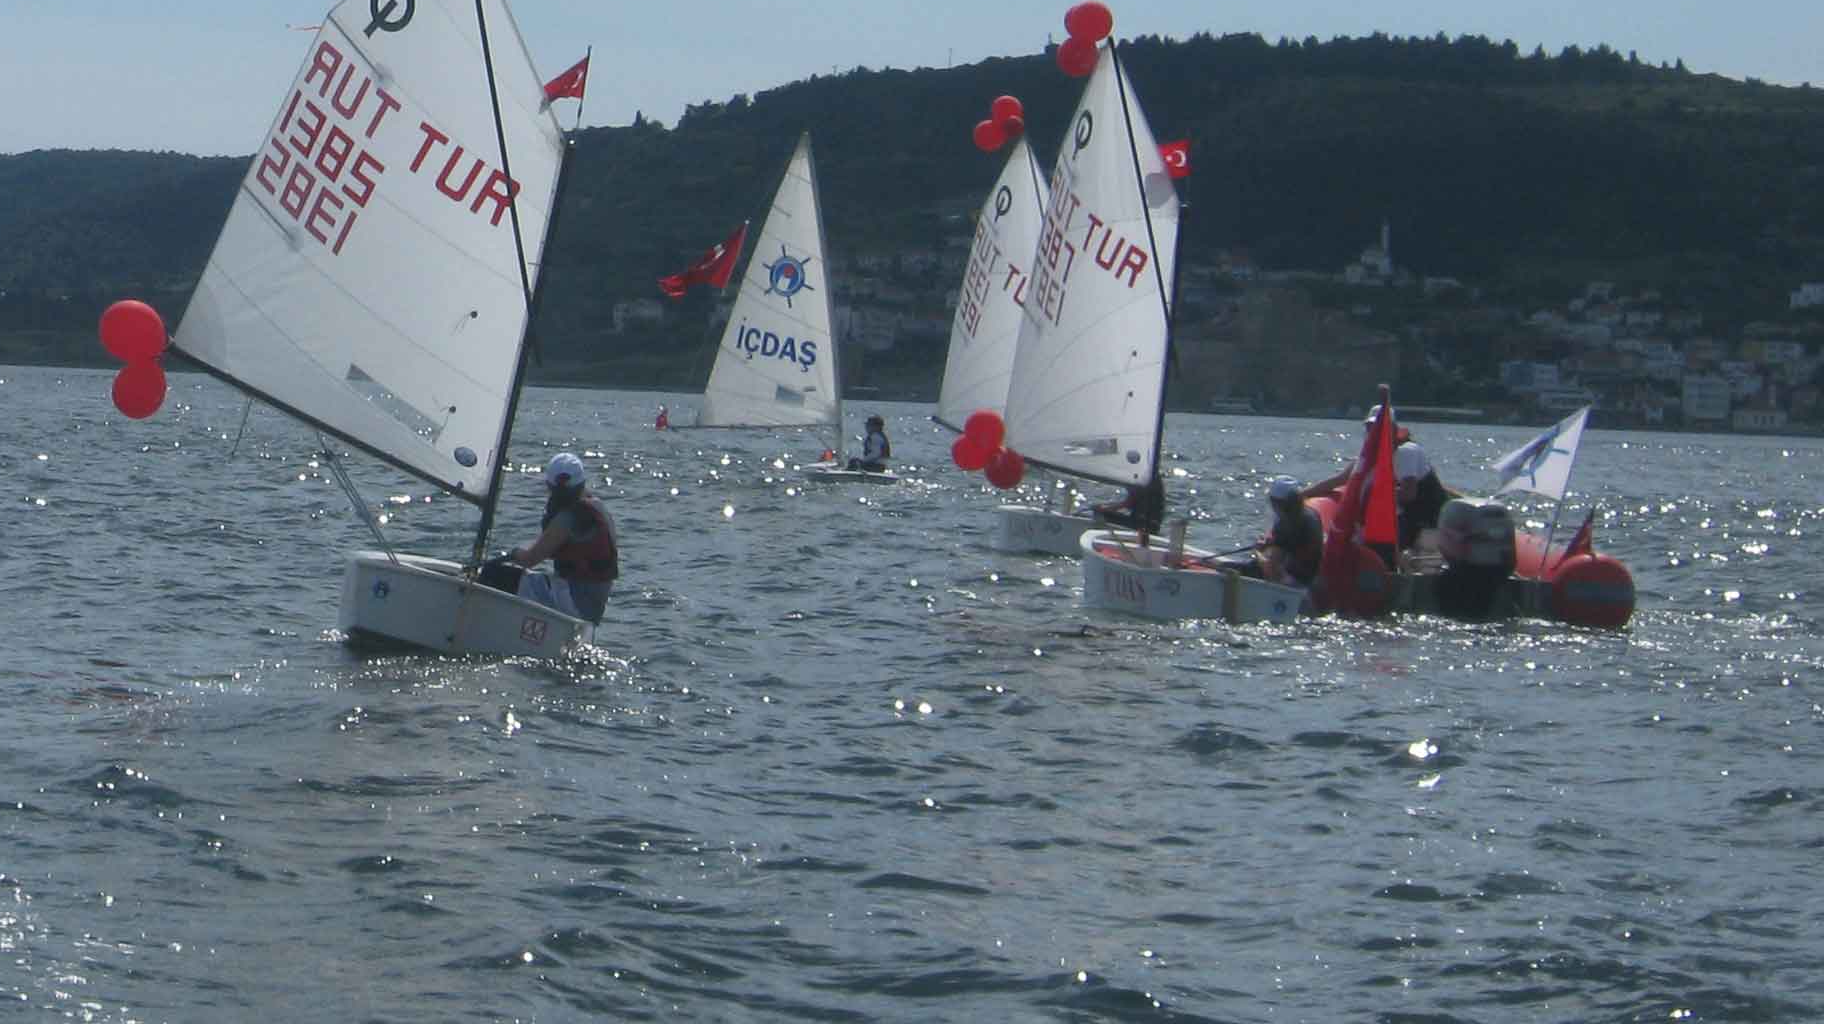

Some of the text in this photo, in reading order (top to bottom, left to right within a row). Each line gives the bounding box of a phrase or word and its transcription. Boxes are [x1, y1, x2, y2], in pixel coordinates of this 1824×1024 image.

[279, 89, 385, 208] 1385
[409, 121, 521, 227] TUR
[1083, 212, 1148, 288] TUR
[736, 316, 817, 373] İÇDAŞ
